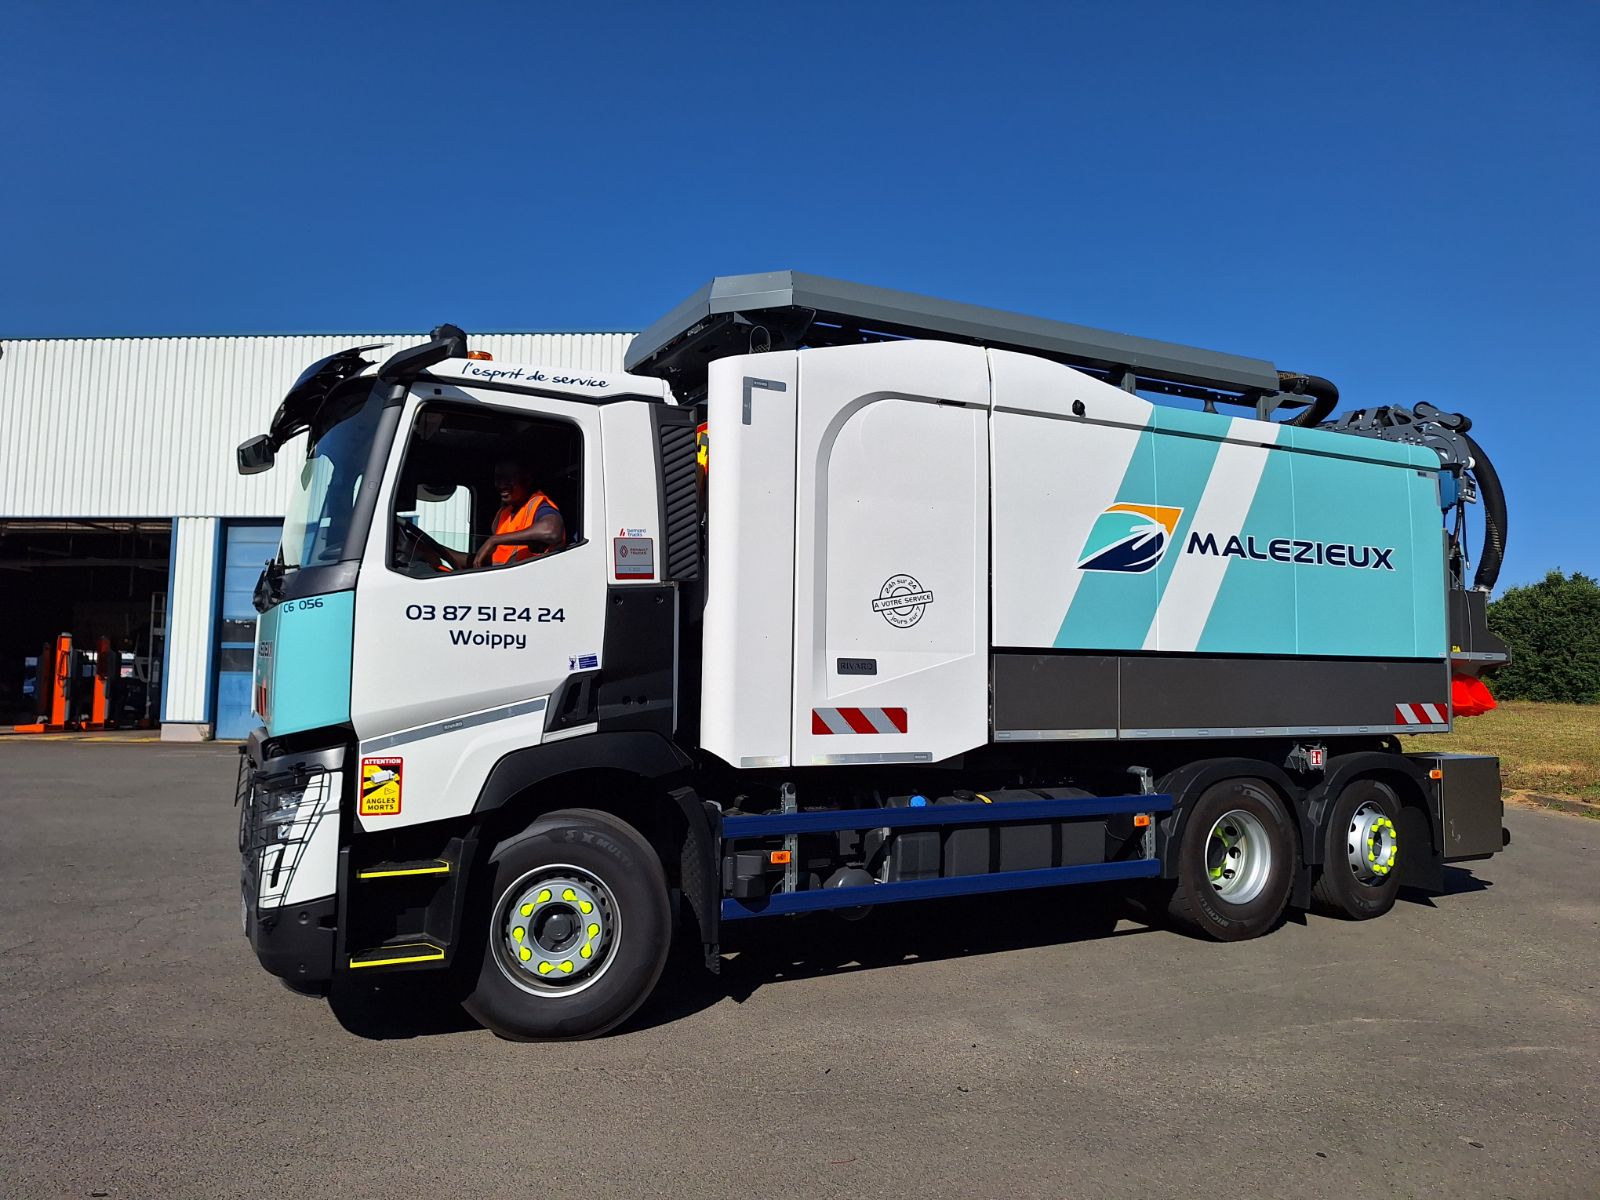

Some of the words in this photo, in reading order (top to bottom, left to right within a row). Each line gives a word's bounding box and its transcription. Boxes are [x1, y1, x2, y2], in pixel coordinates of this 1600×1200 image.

[461, 361, 524, 382] l'esprit
[526, 370, 549, 382] de
[551, 376, 610, 388] service
[1186, 531, 1395, 571] MALEZIEUX
[298, 597, 324, 610] 056
[880, 598, 902, 608] VOTRE
[904, 593, 931, 604] SERVICE
[405, 604, 436, 621] 03
[442, 605, 472, 621] 87
[477, 606, 497, 622] 51
[503, 606, 532, 622] 24
[537, 607, 566, 623] 24
[449, 629, 527, 649] Woippy
[840, 662, 873, 671] RIVARD
